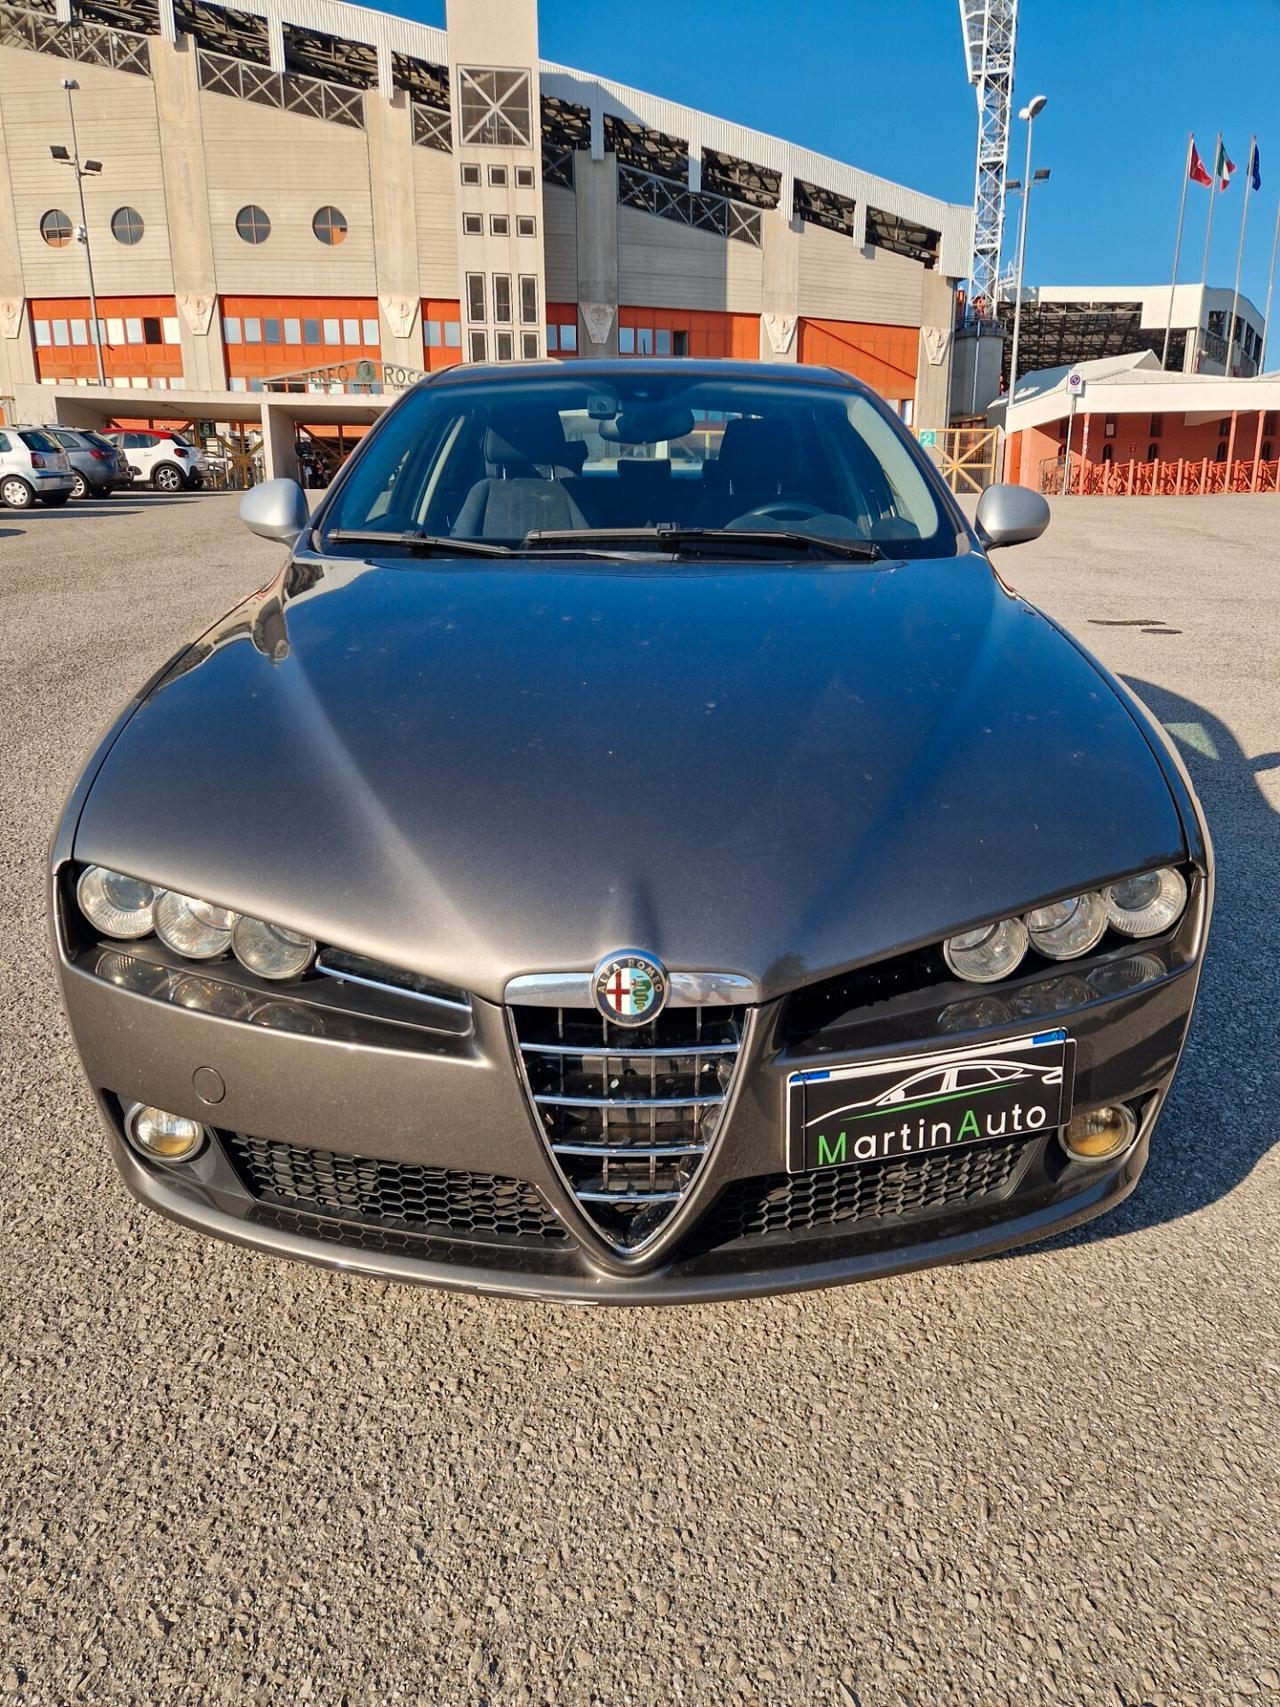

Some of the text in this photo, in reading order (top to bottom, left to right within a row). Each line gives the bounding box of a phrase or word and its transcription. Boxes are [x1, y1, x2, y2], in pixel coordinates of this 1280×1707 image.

[204, 423, 210, 435] 6
[922, 432, 932, 446] 2
[598, 959, 663, 993] ALFA ROMEO
[817, 1103, 1047, 1165] MartinAuto
